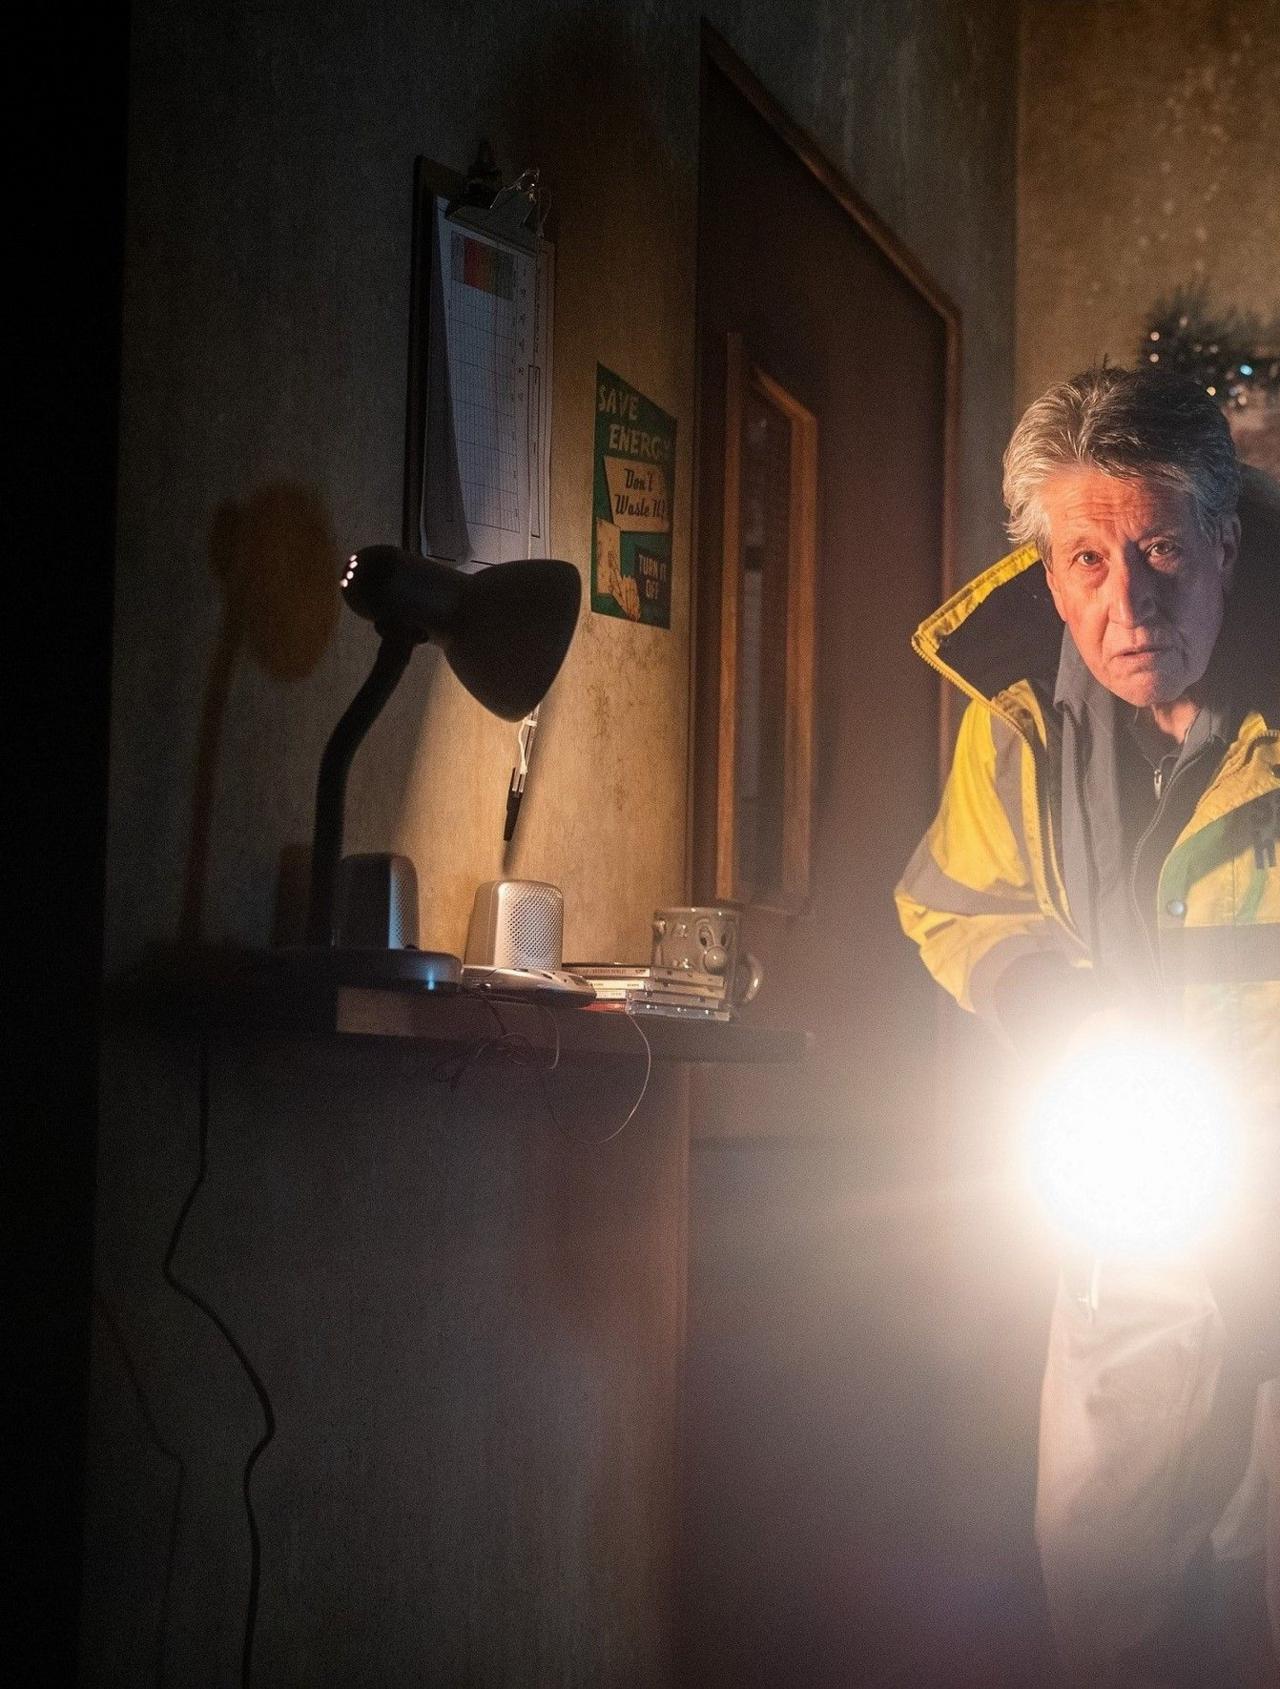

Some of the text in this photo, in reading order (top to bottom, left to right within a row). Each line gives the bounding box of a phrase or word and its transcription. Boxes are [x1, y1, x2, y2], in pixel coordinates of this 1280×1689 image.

[598, 383, 640, 421] SAVE
[623, 468, 653, 492] Don't
[614, 493, 649, 518] Waste
